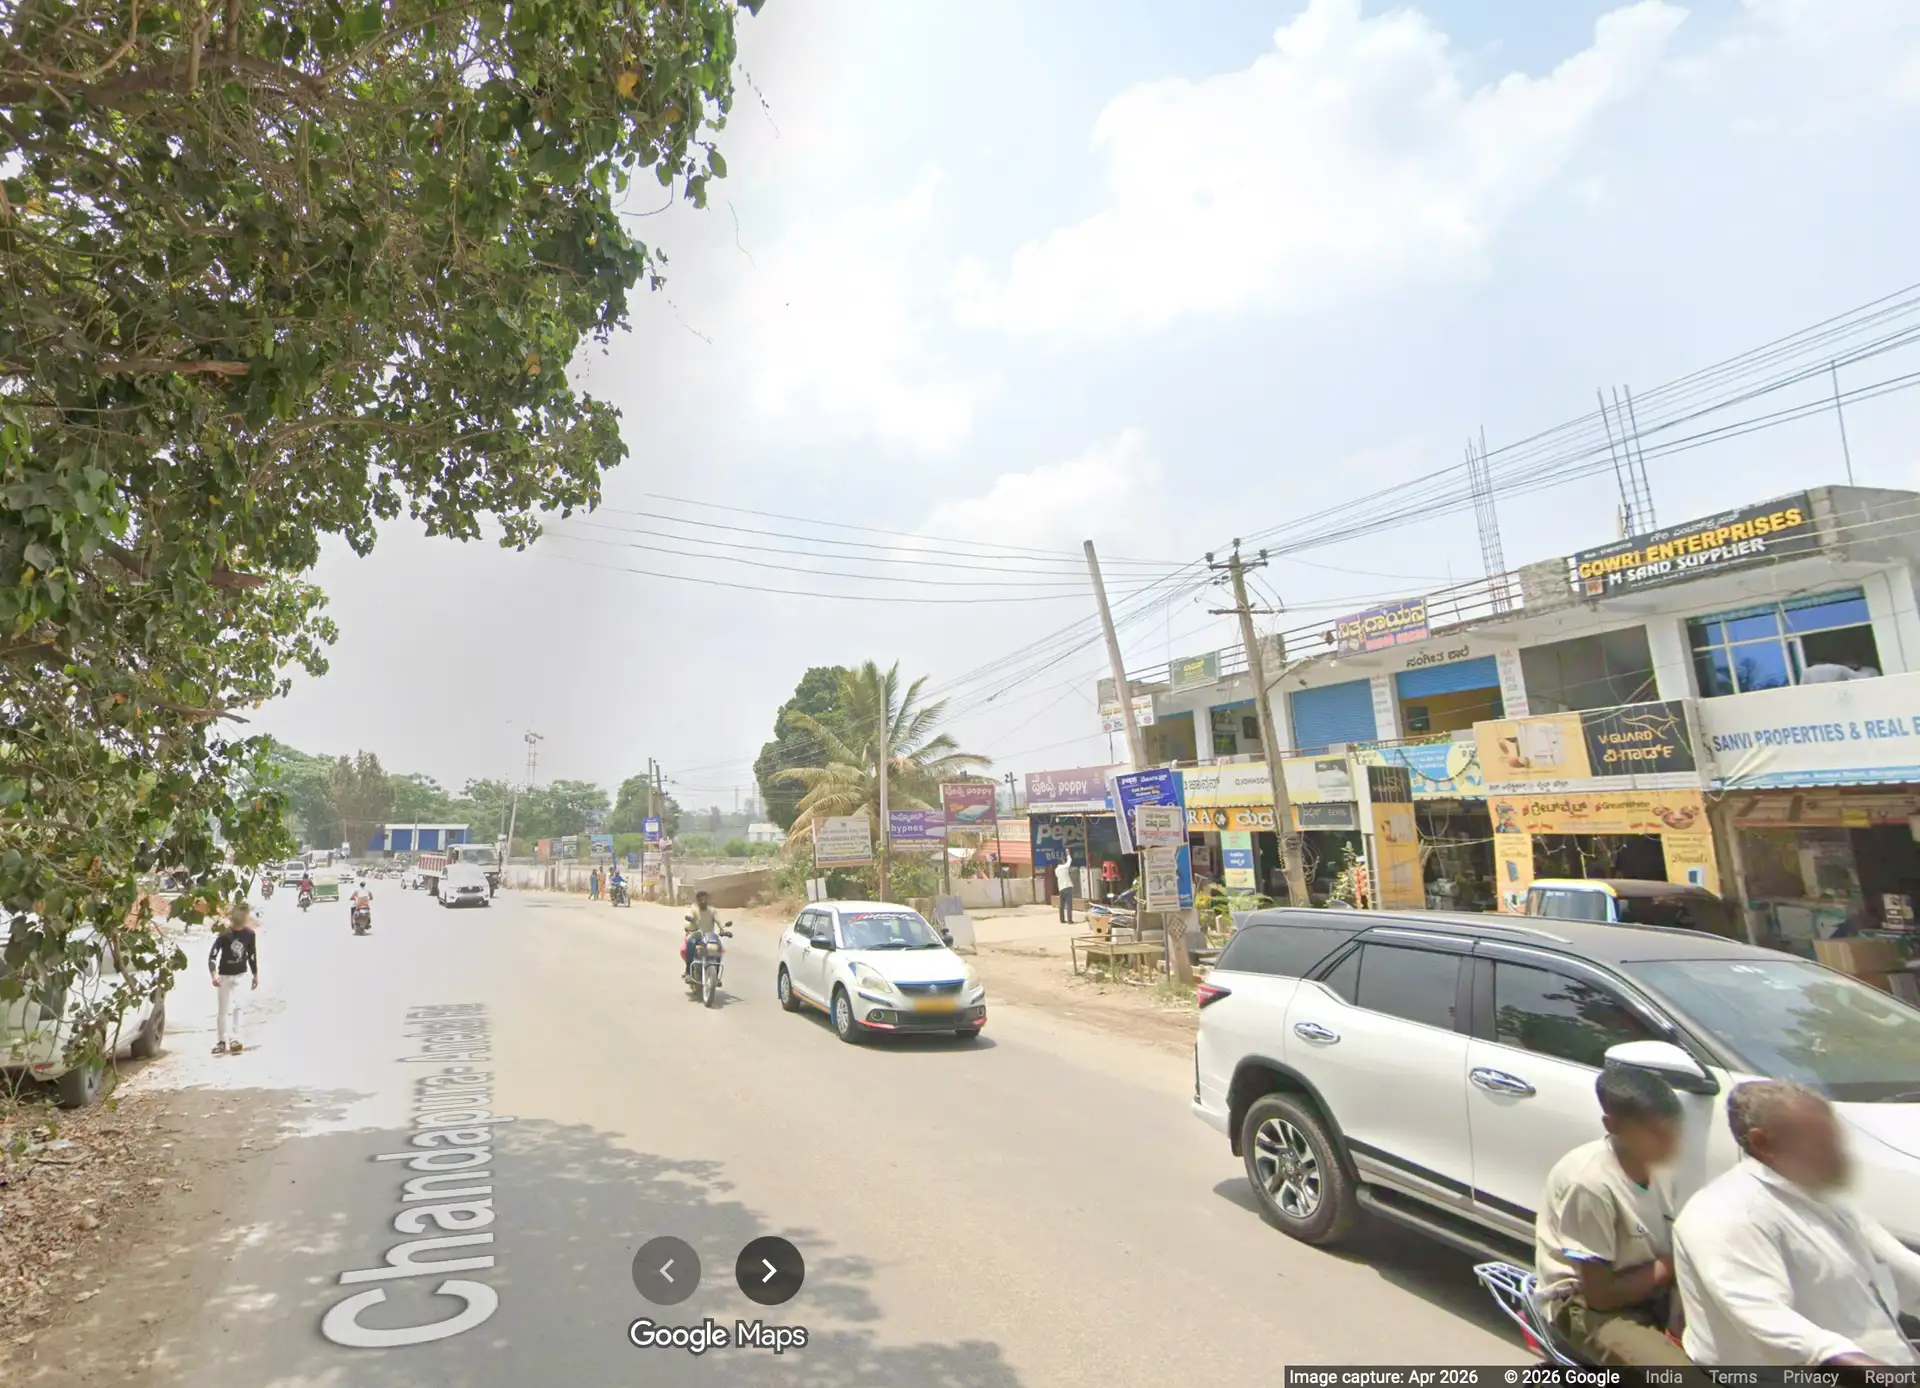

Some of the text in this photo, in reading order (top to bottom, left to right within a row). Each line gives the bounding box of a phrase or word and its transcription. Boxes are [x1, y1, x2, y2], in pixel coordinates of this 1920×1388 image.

[1579, 552, 1641, 579] GOWRI
[1647, 507, 1802, 564] ENTERPRISES
[1608, 571, 1623, 587] M
[1627, 560, 1672, 582] SAND
[1677, 538, 1767, 570] SUPPLIER
[1712, 732, 1753, 753] SANVI
[1755, 722, 1845, 750] PROPERTIES
[1849, 721, 1861, 740] &
[1864, 717, 1910, 739] REAL
[966, 787, 992, 796] poppy
[1058, 780, 1089, 796] poppy
[890, 824, 924, 834] hypnos
